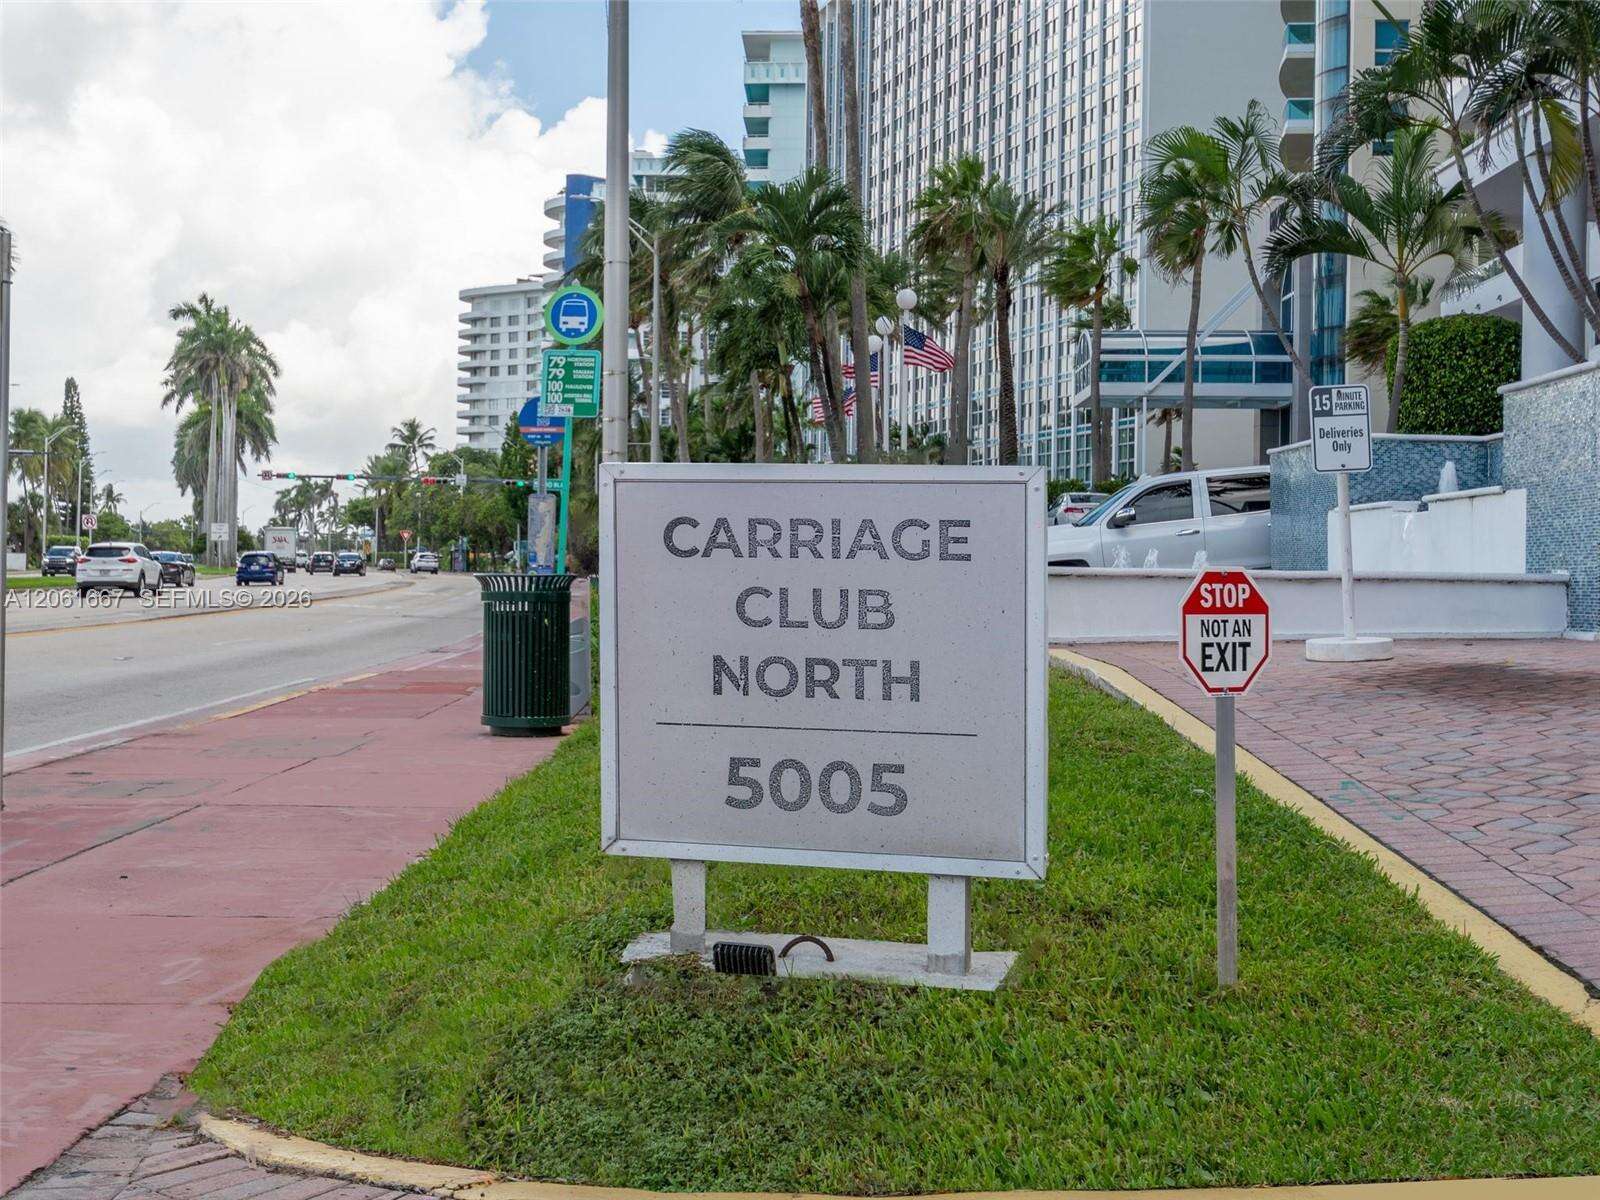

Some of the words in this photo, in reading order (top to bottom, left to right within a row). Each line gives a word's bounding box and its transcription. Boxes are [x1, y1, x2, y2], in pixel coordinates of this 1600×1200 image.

[549, 356, 566, 367] 79
[548, 368, 565, 379] 79
[547, 381, 563, 392] 100
[547, 393, 563, 403] 100
[1314, 394, 1331, 411] 15
[1336, 391, 1362, 401] MINUTE
[1334, 401, 1366, 411] PARKING
[1319, 426, 1364, 439] Deliveries
[1332, 440, 1352, 454] Only
[663, 516, 972, 562] CARRIAGE
[1199, 582, 1251, 608] STOP
[735, 586, 896, 630] CLUB
[1200, 619, 1229, 638] NOT
[1231, 619, 1252, 638] AN
[1200, 641, 1251, 673] EXIT
[712, 654, 920, 702] NORTH
[725, 756, 908, 817] 5005
